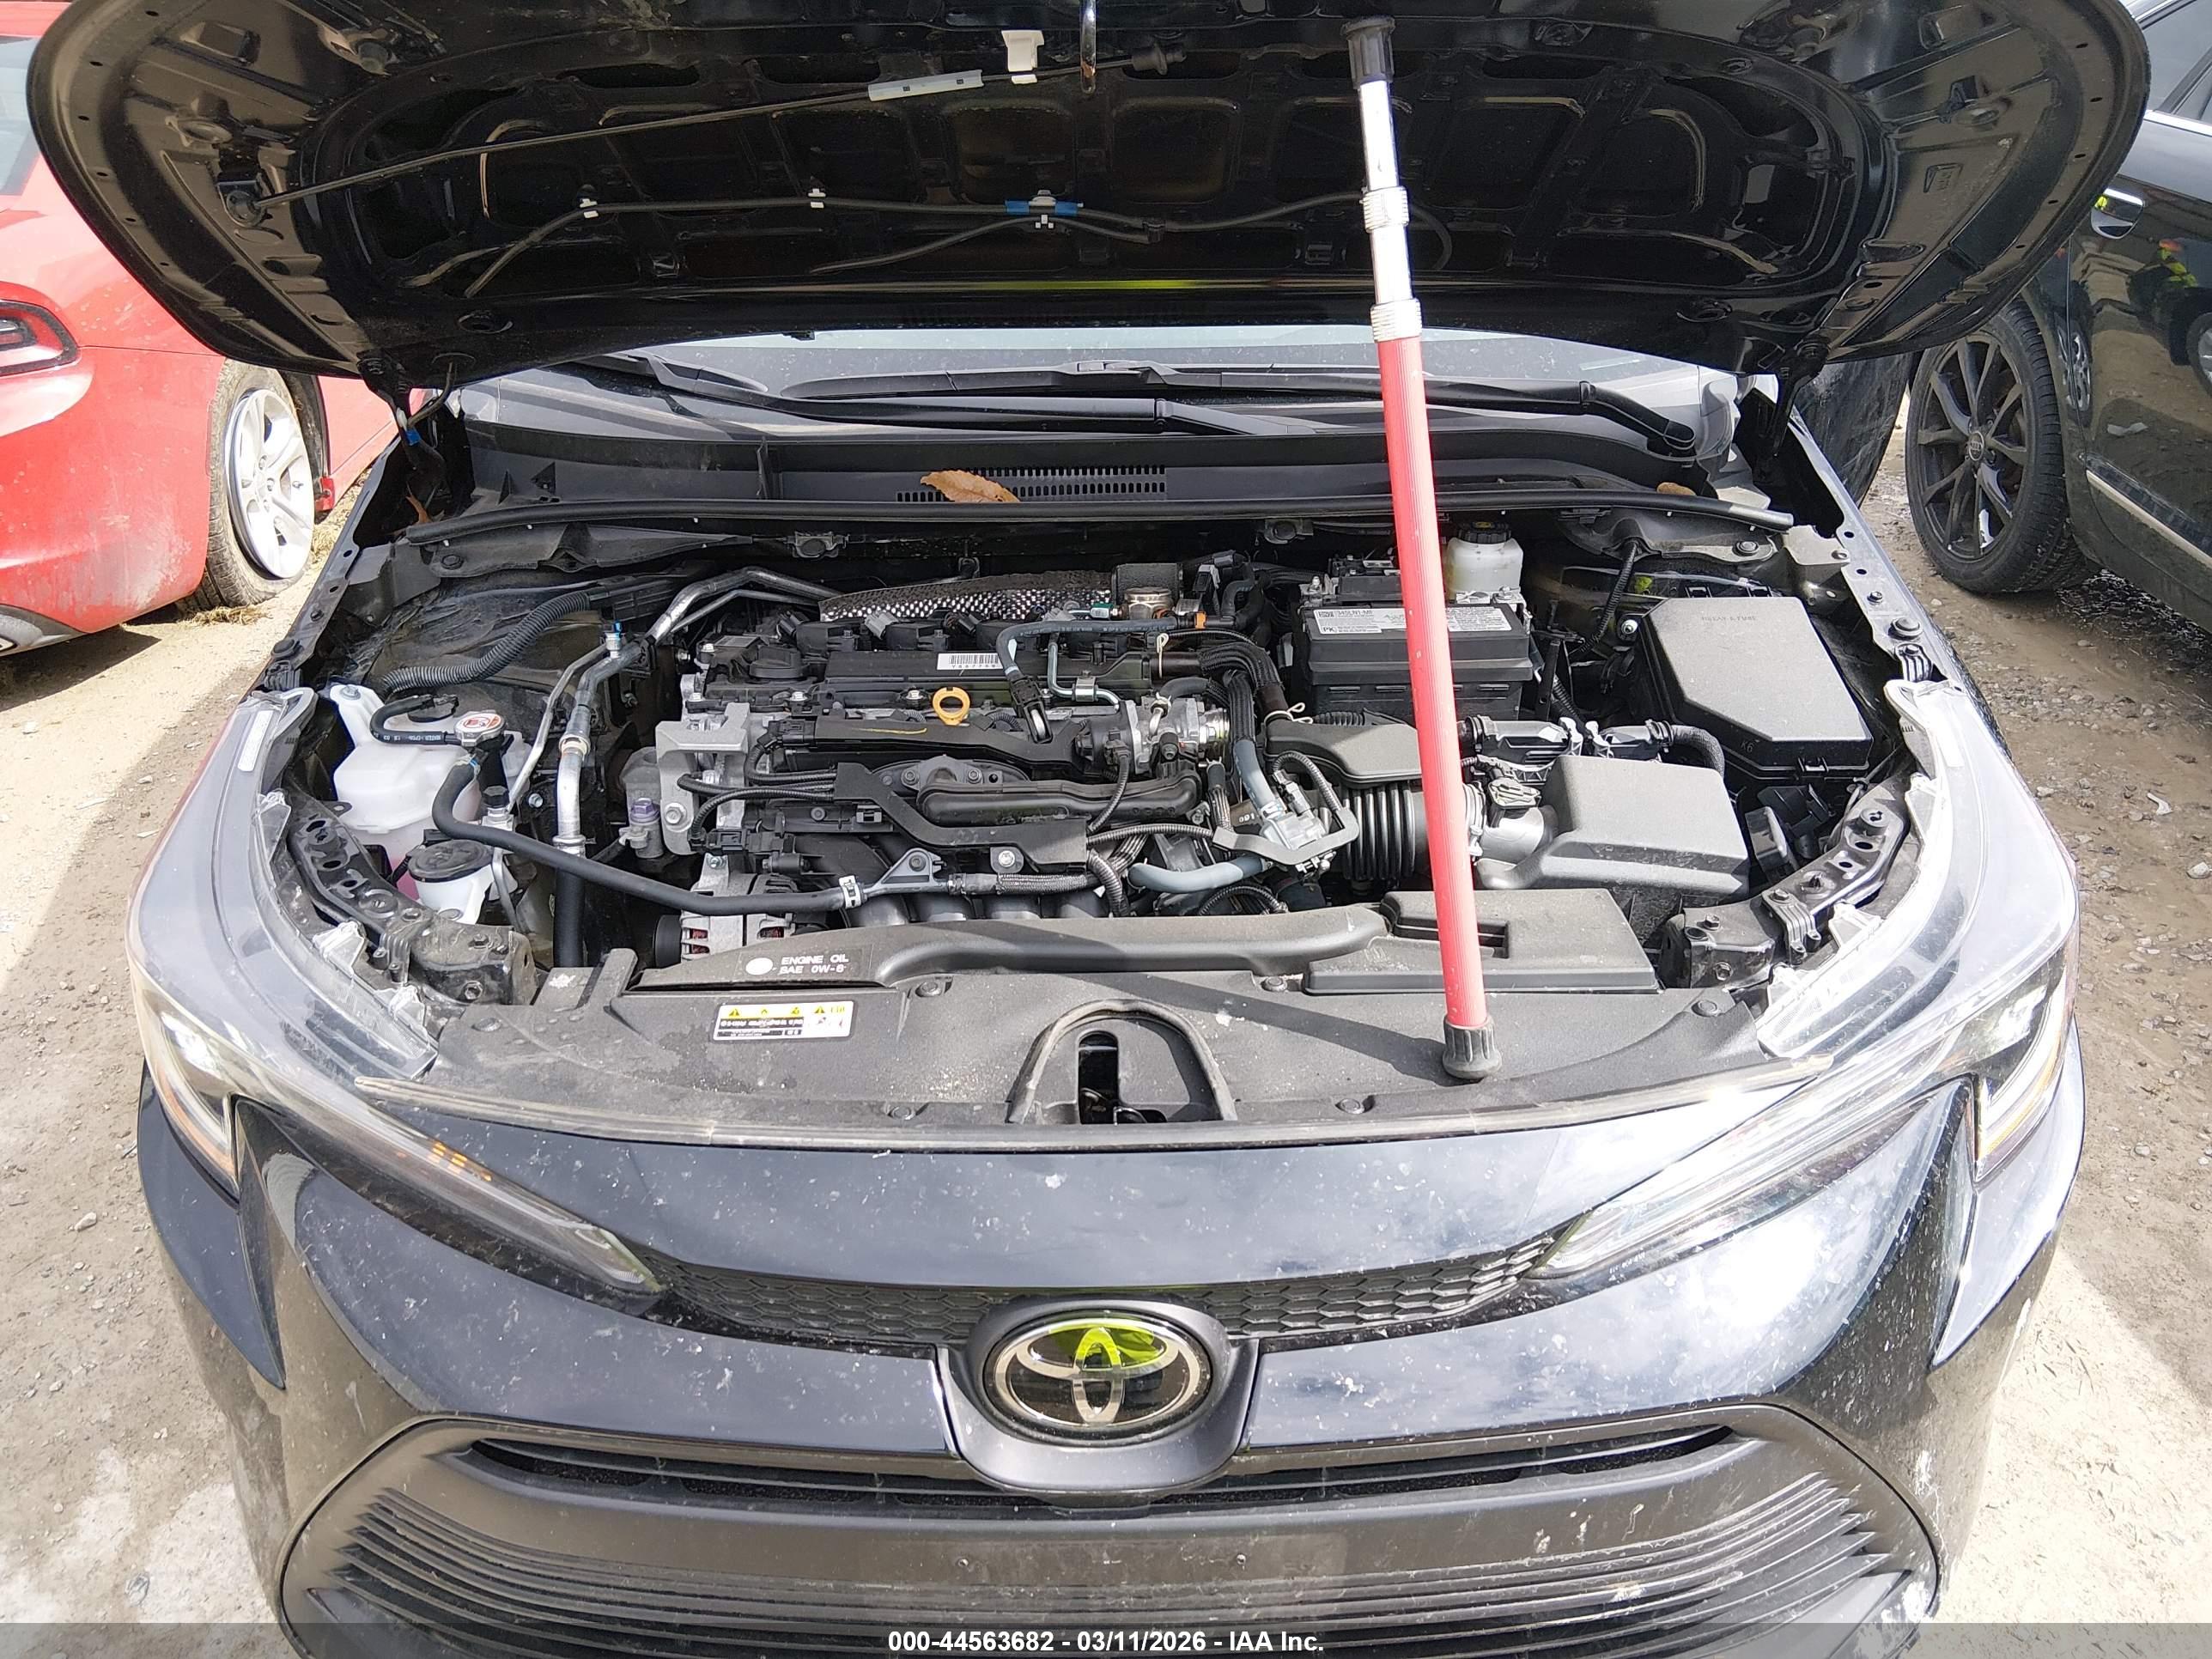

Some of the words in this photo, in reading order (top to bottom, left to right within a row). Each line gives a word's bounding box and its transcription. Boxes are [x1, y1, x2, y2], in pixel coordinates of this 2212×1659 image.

[781, 955, 824, 965] ENGINE
[830, 953, 849, 963] OIL
[780, 965, 805, 975] SAE
